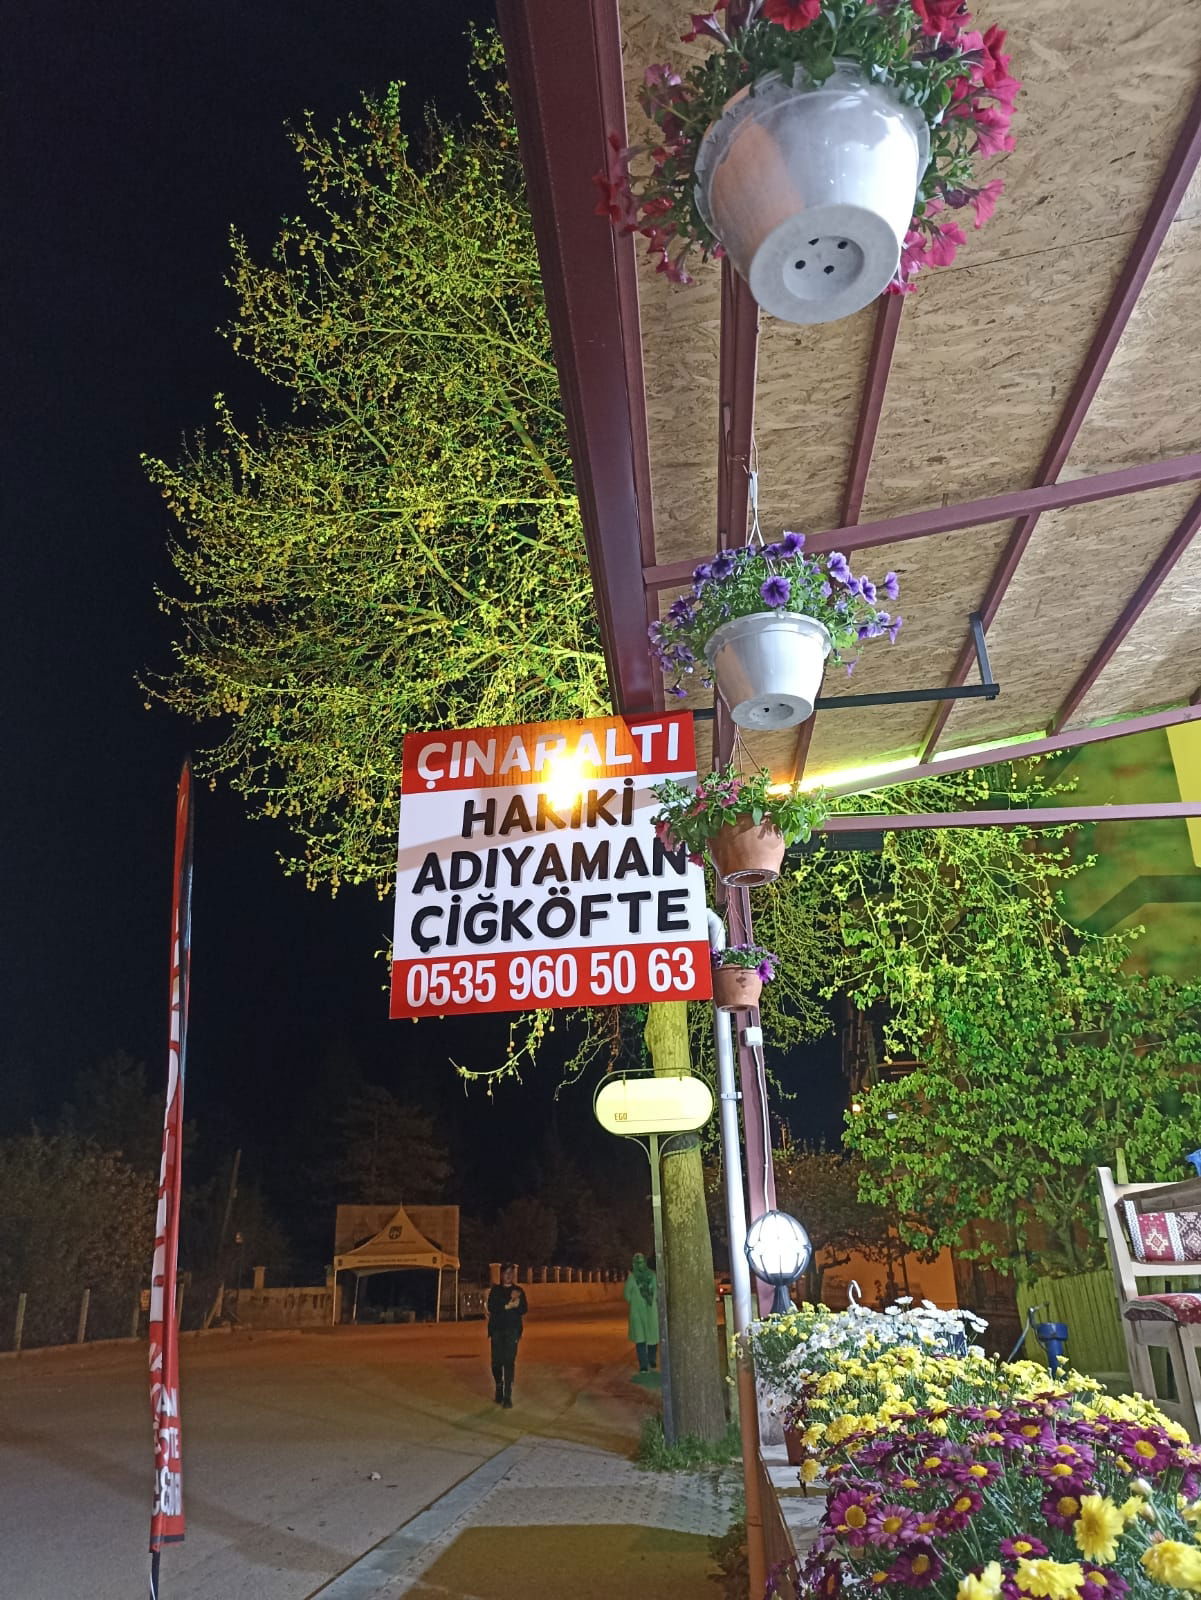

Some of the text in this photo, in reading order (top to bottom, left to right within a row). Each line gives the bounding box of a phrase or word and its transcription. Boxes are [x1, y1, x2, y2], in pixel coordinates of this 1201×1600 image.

[417, 722, 680, 790] ÇINARALTI
[412, 837, 687, 894] ADIYAMAN
[411, 886, 690, 953] ÇİĞKÖFTE
[406, 947, 696, 1007] 0535 960 50 63
